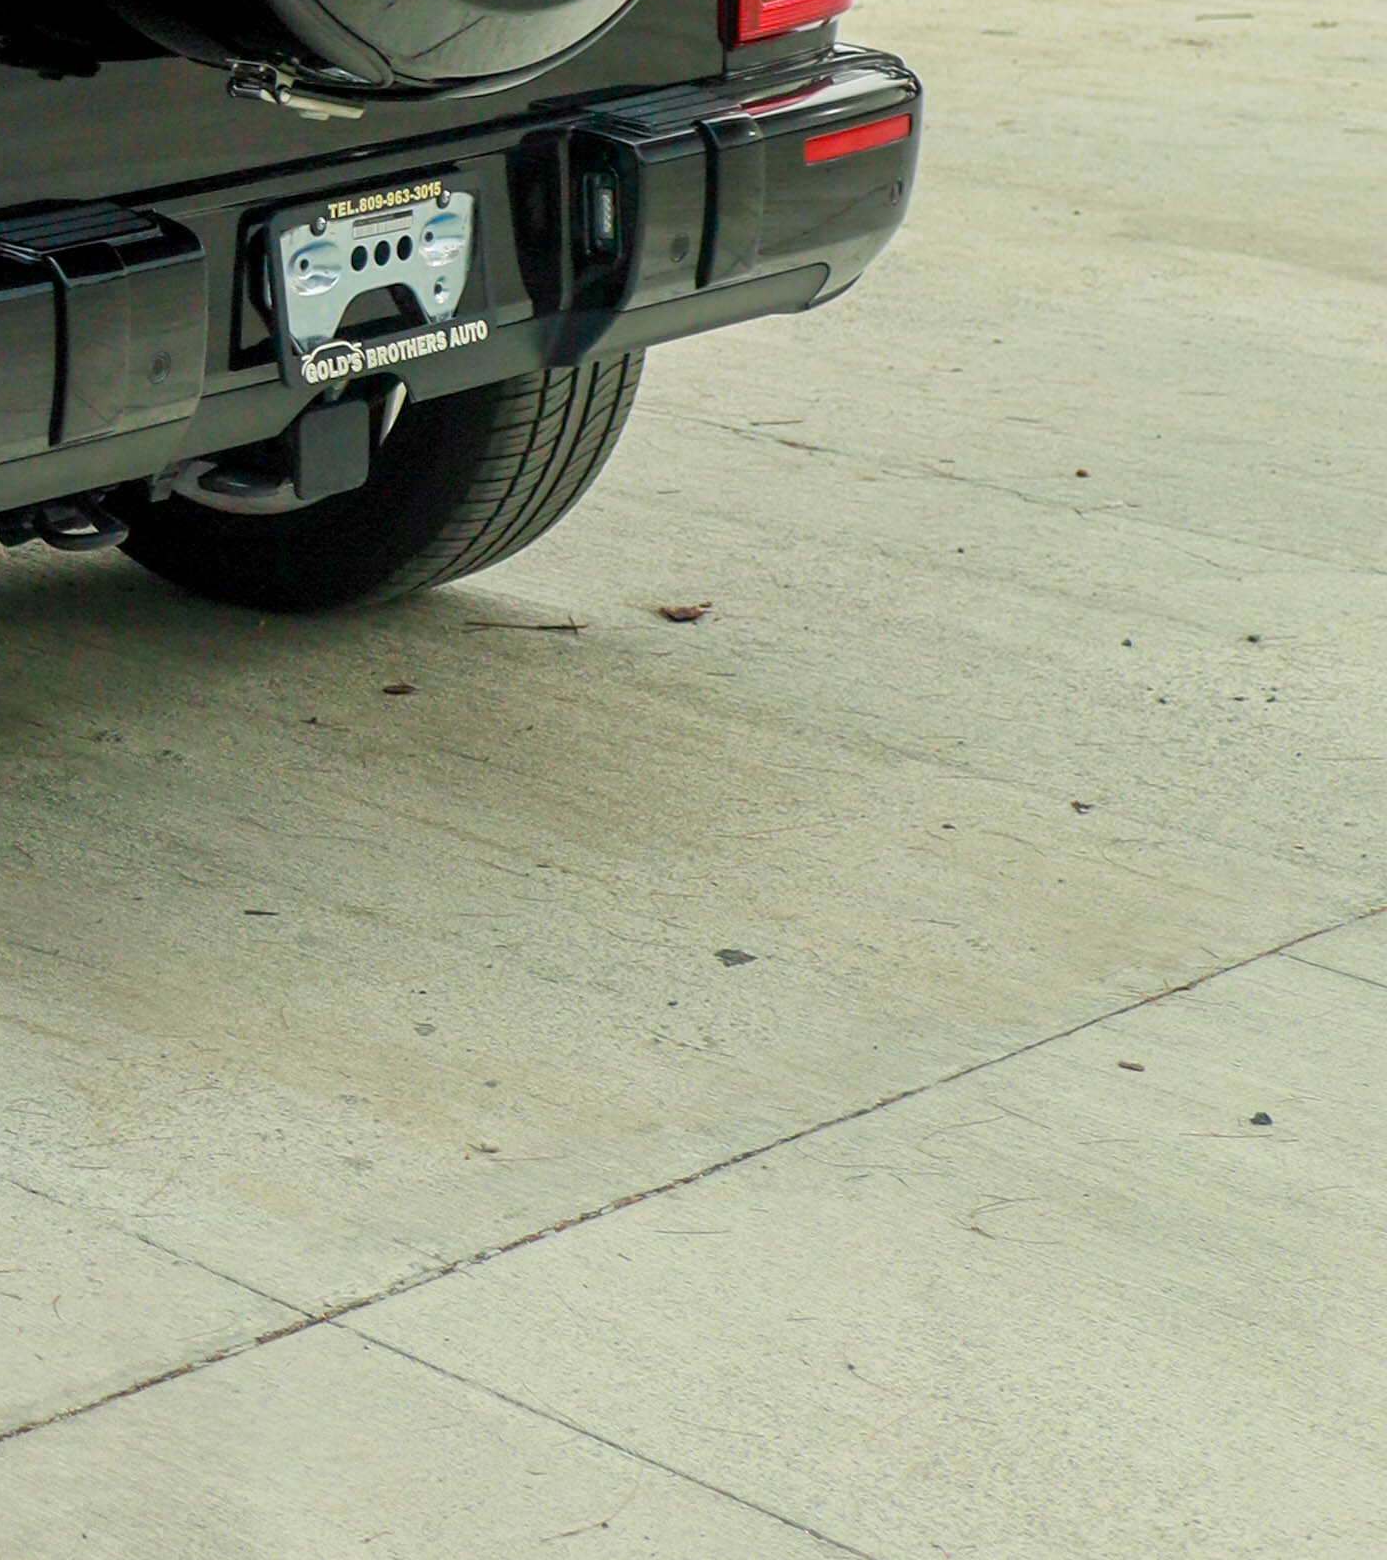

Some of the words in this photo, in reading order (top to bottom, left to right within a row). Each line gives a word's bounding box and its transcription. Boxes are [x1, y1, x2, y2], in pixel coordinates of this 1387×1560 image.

[305, 351, 364, 385] GOLD'S
[367, 330, 448, 369] BROTHERS
[449, 319, 488, 348] AUTO
